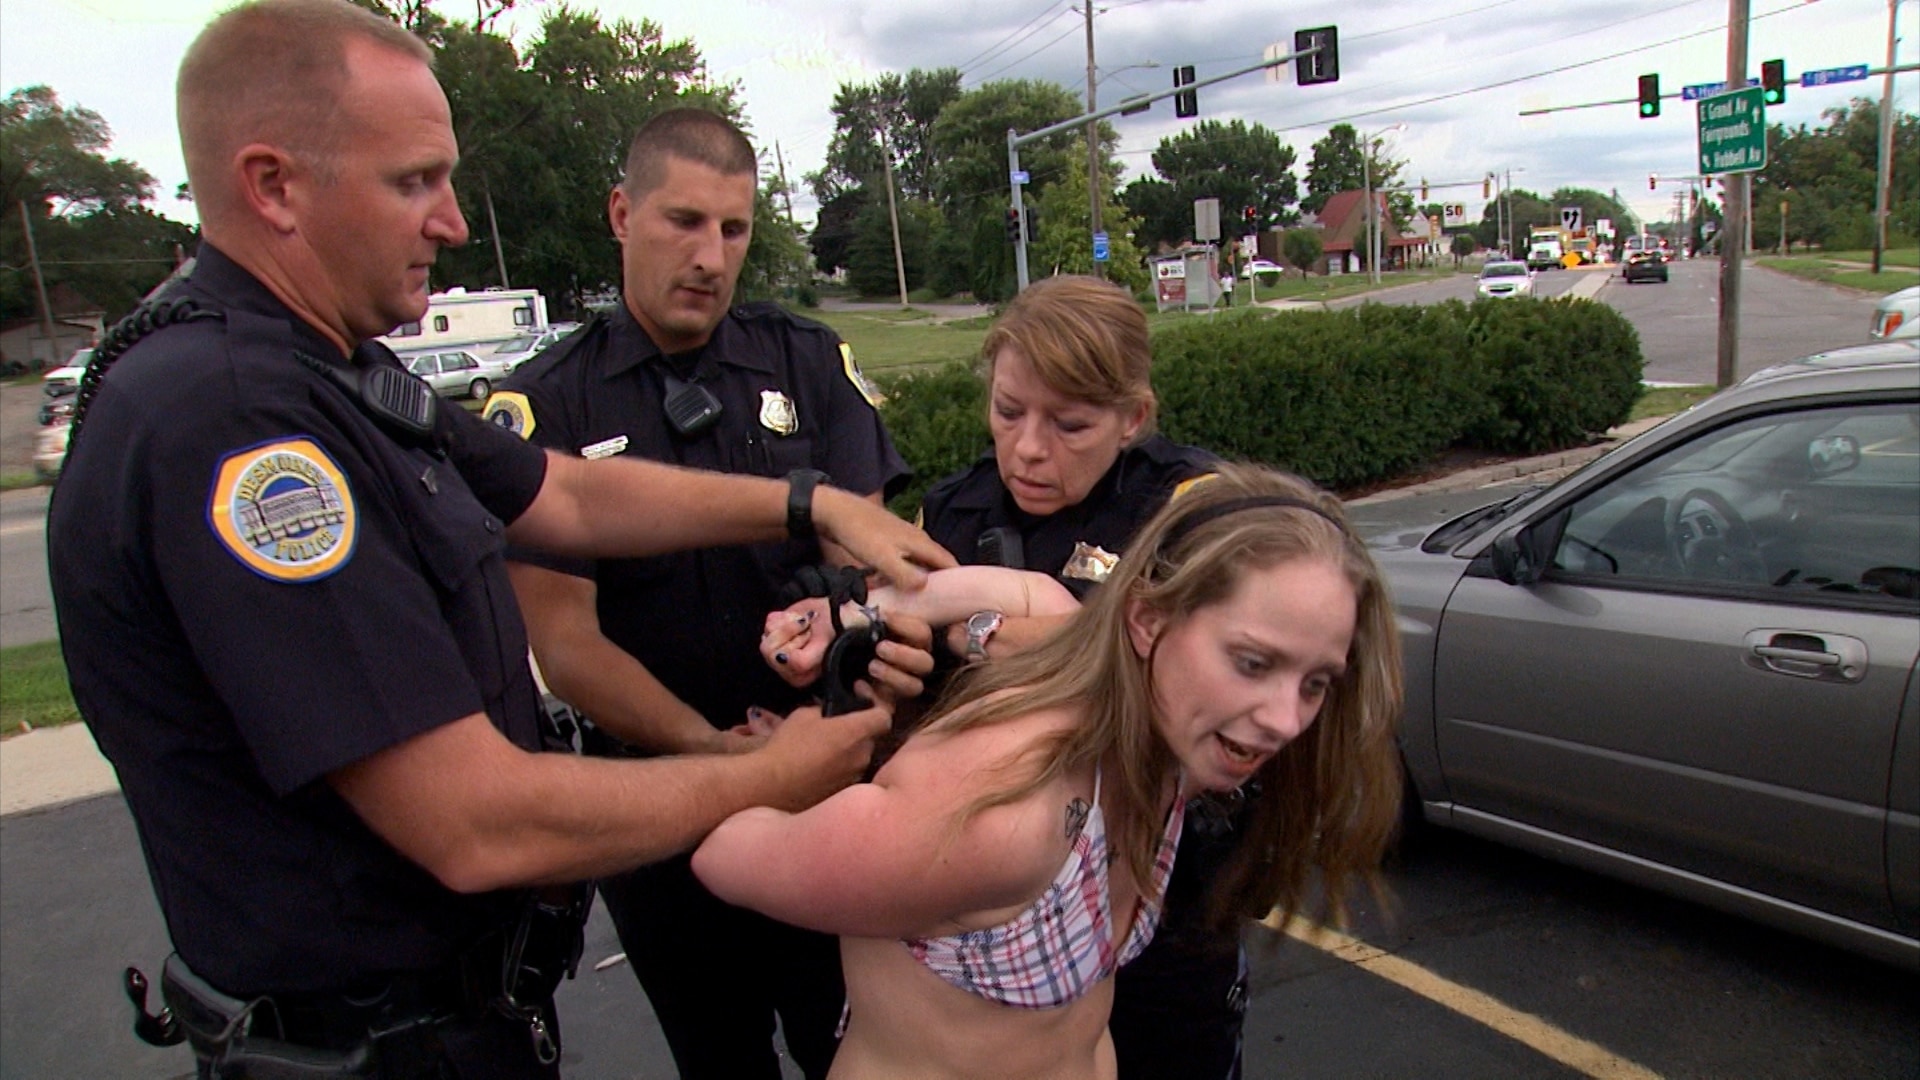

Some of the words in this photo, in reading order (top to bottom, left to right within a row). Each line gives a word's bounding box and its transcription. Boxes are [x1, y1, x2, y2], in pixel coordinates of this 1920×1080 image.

[1700, 104, 1706, 122] E
[1708, 99, 1733, 120] Grand
[1734, 97, 1748, 115] Av
[1701, 119, 1749, 145] Fairgrounds
[1714, 147, 1746, 168] Hubbell
[1748, 145, 1762, 164] Av
[238, 468, 266, 501] DES
[261, 454, 324, 484] MOINES
[274, 530, 337, 561] POLICE
